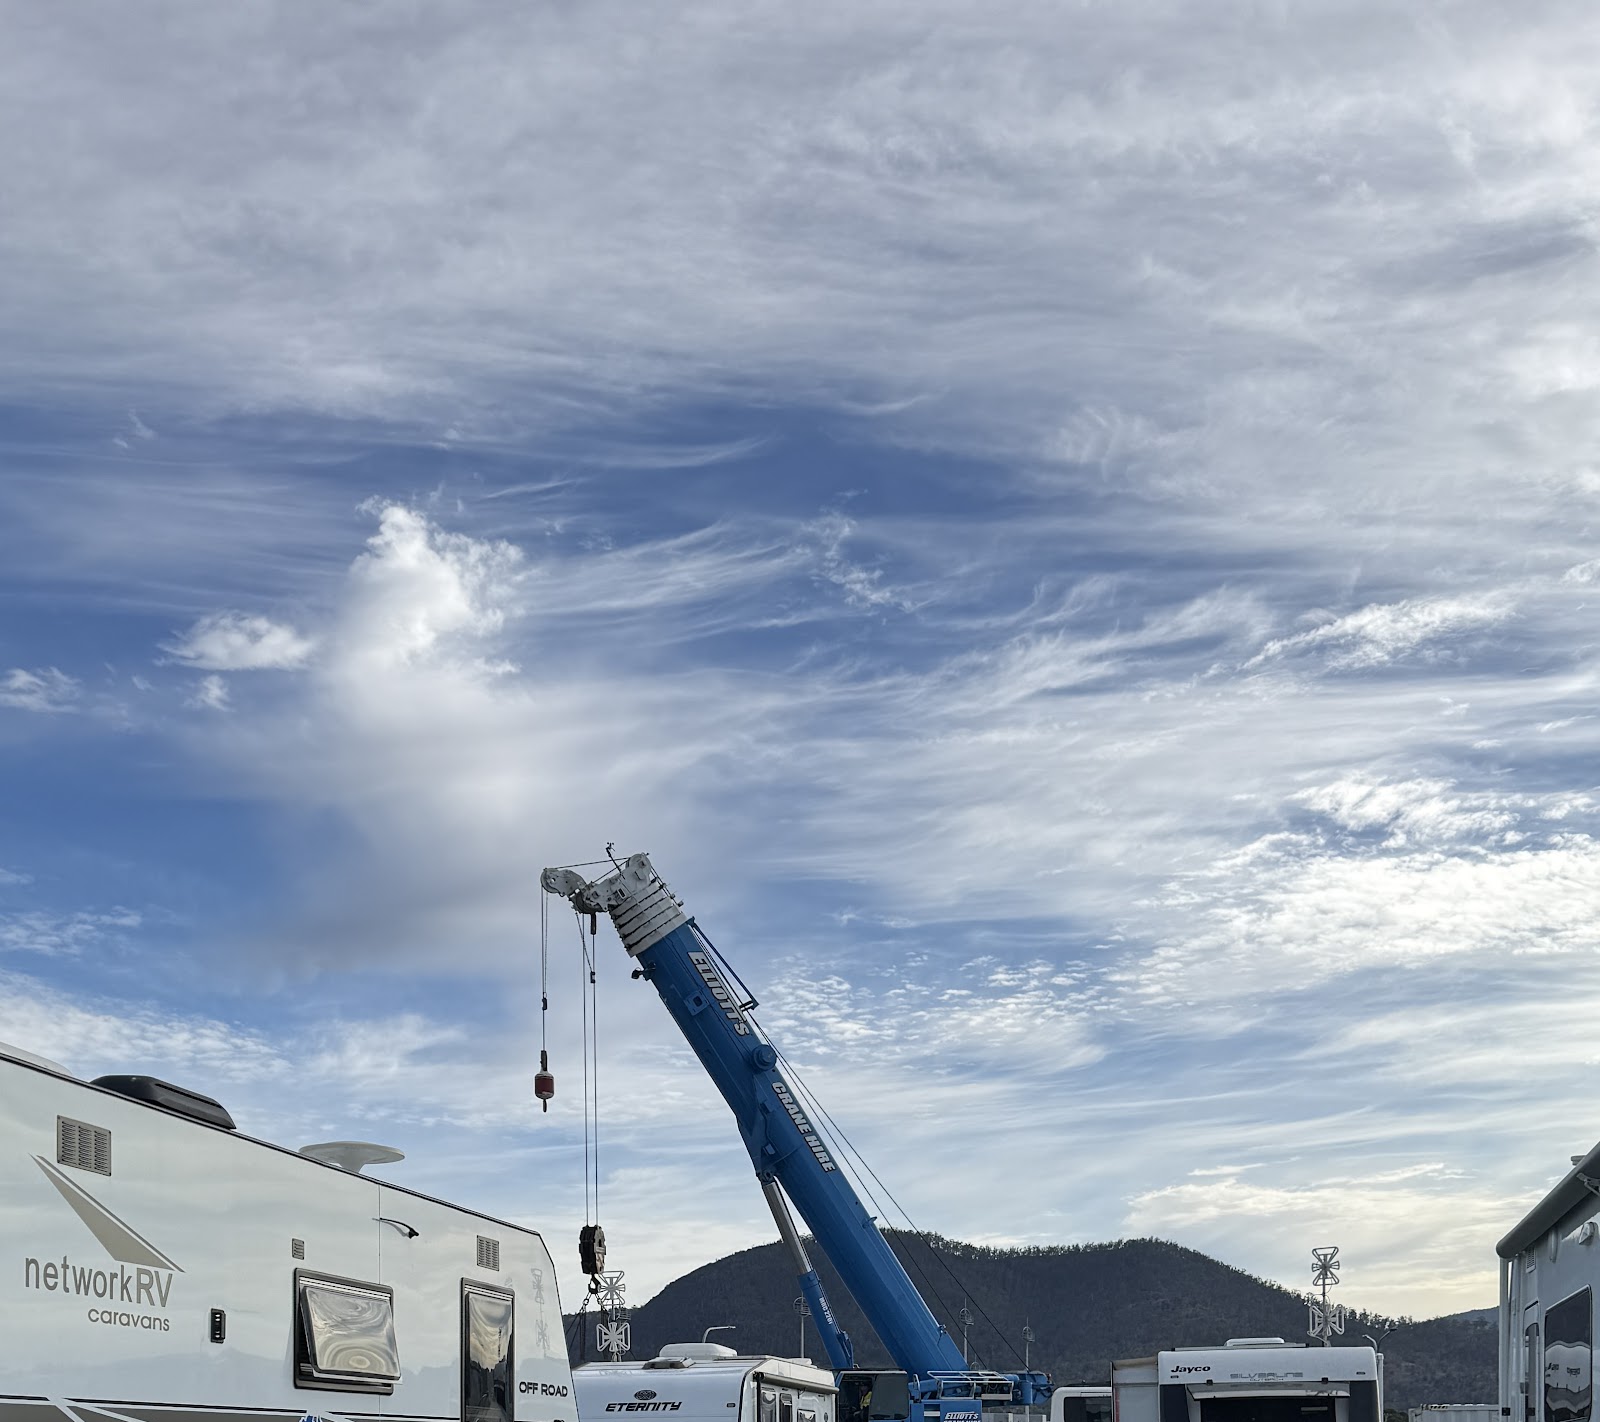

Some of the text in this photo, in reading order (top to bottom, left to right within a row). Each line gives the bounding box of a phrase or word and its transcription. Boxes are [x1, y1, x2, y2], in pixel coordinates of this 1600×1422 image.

[687, 950, 750, 1037] ELLIOTT'S
[771, 1081, 836, 1173] CRANE HIRE
[87, 1308, 170, 1332] caravans
[1170, 1365, 1211, 1374] Jayco
[519, 1381, 568, 1398] OFF ROAD
[605, 1401, 683, 1412] ETERNITY
